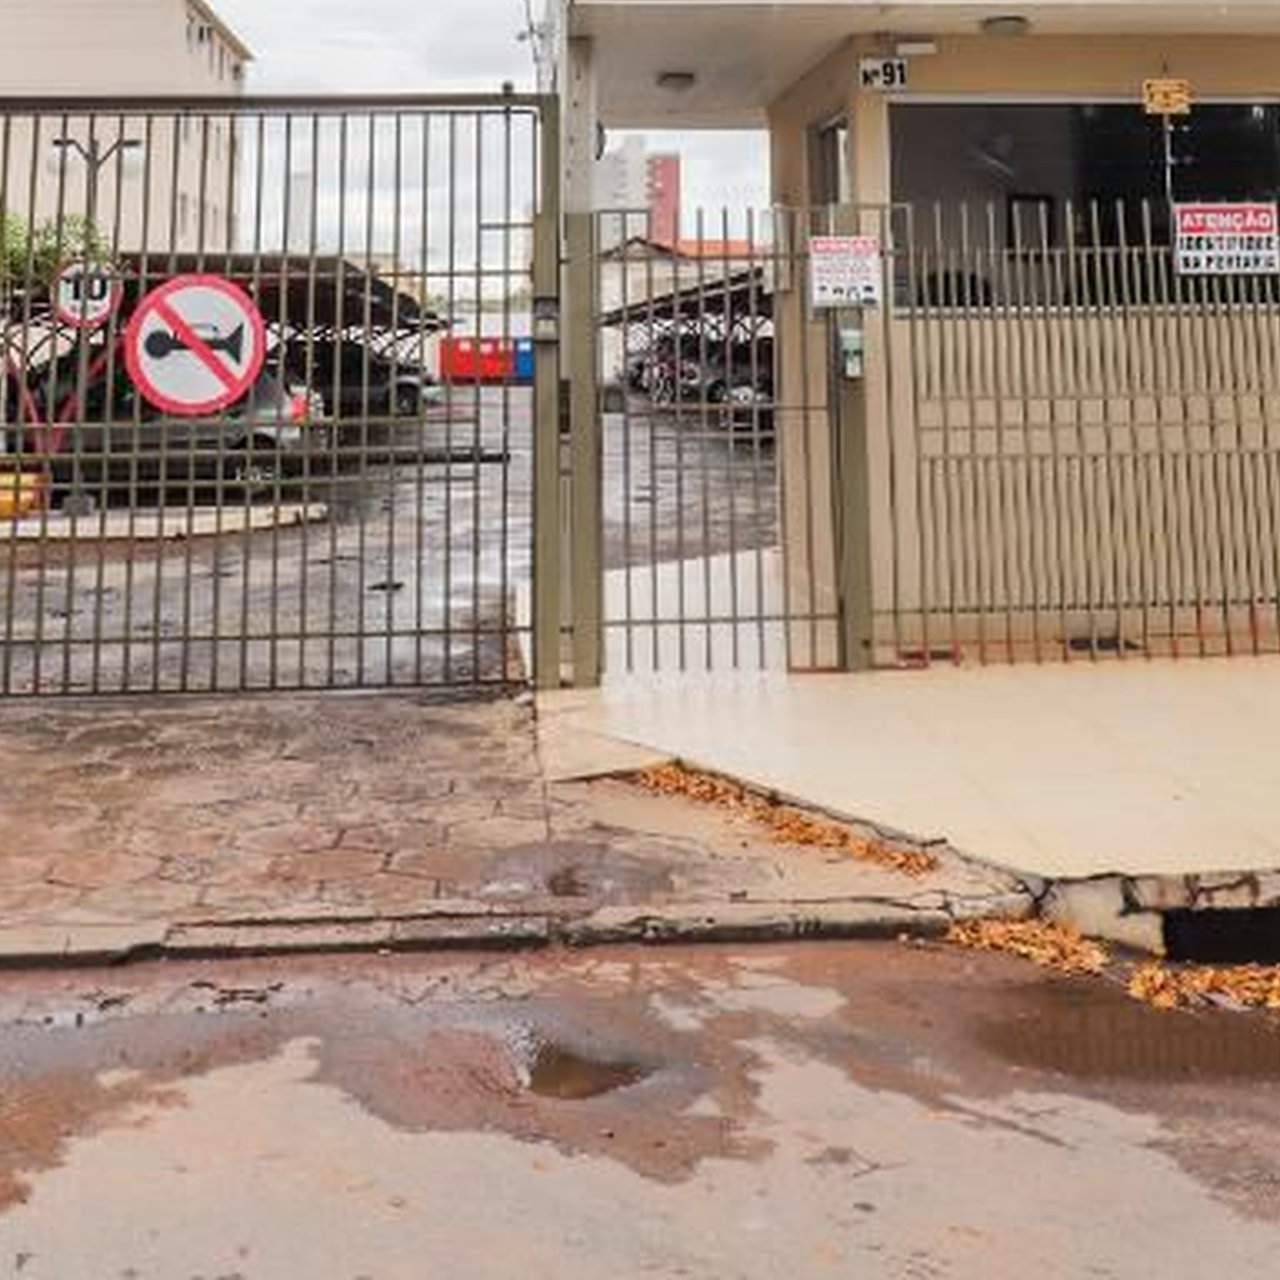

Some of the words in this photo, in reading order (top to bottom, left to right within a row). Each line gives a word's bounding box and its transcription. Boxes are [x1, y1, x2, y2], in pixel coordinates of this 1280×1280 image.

[882, 62, 905, 85] 91
[1183, 209, 1271, 230] ATENÇÃO
[65, 270, 107, 300] 10
